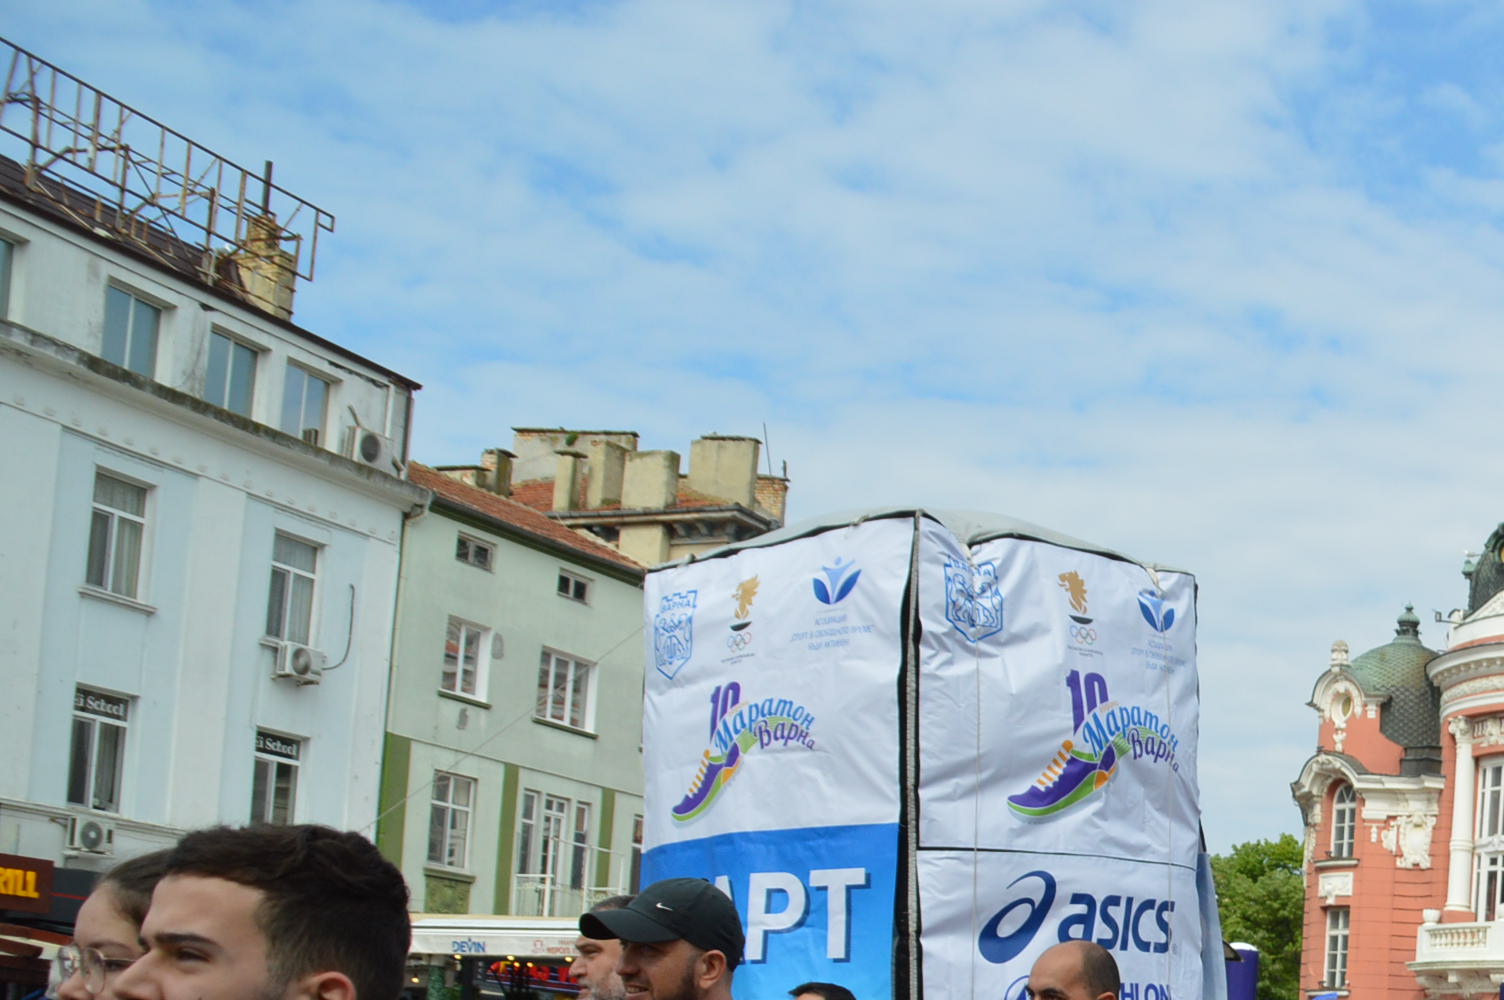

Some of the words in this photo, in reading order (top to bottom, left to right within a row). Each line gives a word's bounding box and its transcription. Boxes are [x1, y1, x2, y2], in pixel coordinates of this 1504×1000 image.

[86, 696, 125, 717] School
[714, 697, 816, 752] Маратон
[754, 719, 817, 750] Варна
[1082, 705, 1179, 760] Маратон
[265, 738, 298, 758] School
[1127, 728, 1180, 772] Варна
[452, 939, 486, 953] DEVIN
